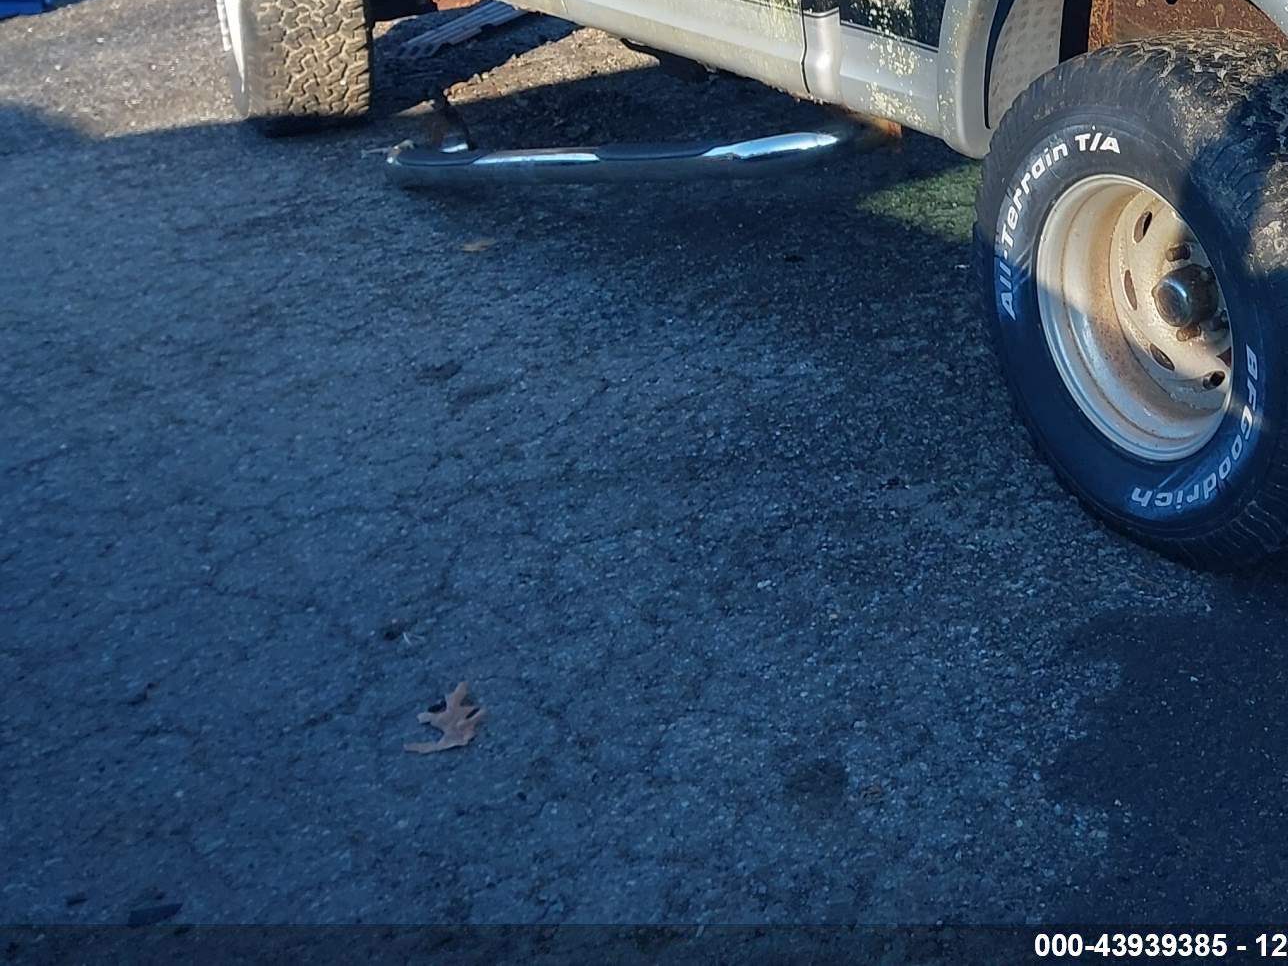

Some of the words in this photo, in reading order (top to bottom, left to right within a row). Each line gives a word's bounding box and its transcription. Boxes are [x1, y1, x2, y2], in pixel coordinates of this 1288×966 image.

[1001, 142, 1069, 321] All-Terrain
[1075, 132, 1121, 155] T/A
[1131, 344, 1258, 510] BFGoodrich
